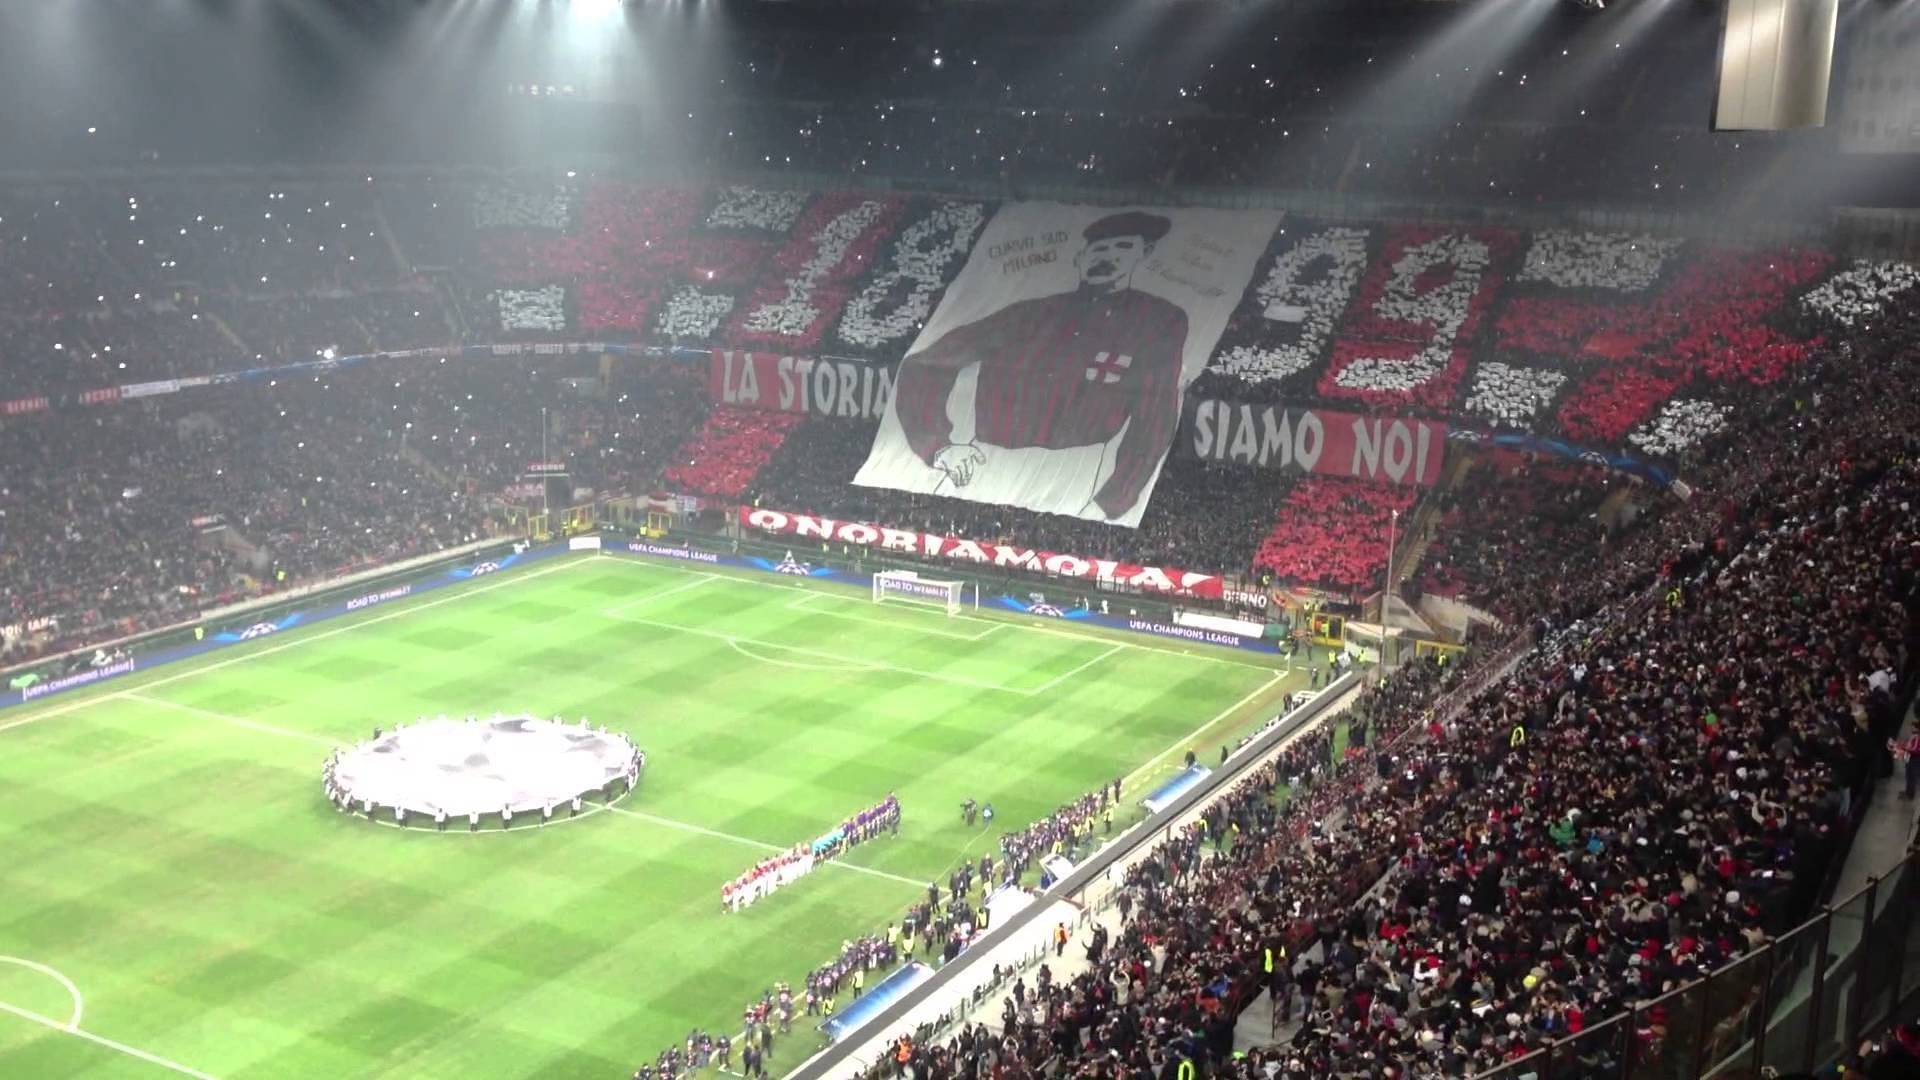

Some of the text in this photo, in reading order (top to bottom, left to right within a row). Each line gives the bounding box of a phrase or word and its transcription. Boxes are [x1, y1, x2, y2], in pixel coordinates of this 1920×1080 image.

[1040, 231, 1069, 245] SUD
[1003, 249, 1057, 275] MILANO
[723, 351, 1431, 484] LA STORIA SIAMO NOI
[629, 543, 718, 562] UEFA CHAMPIONS LEAGUE
[902, 582, 912, 591] TO
[1129, 620, 1239, 646] UEFA CHAMPIONS LEAGUE
